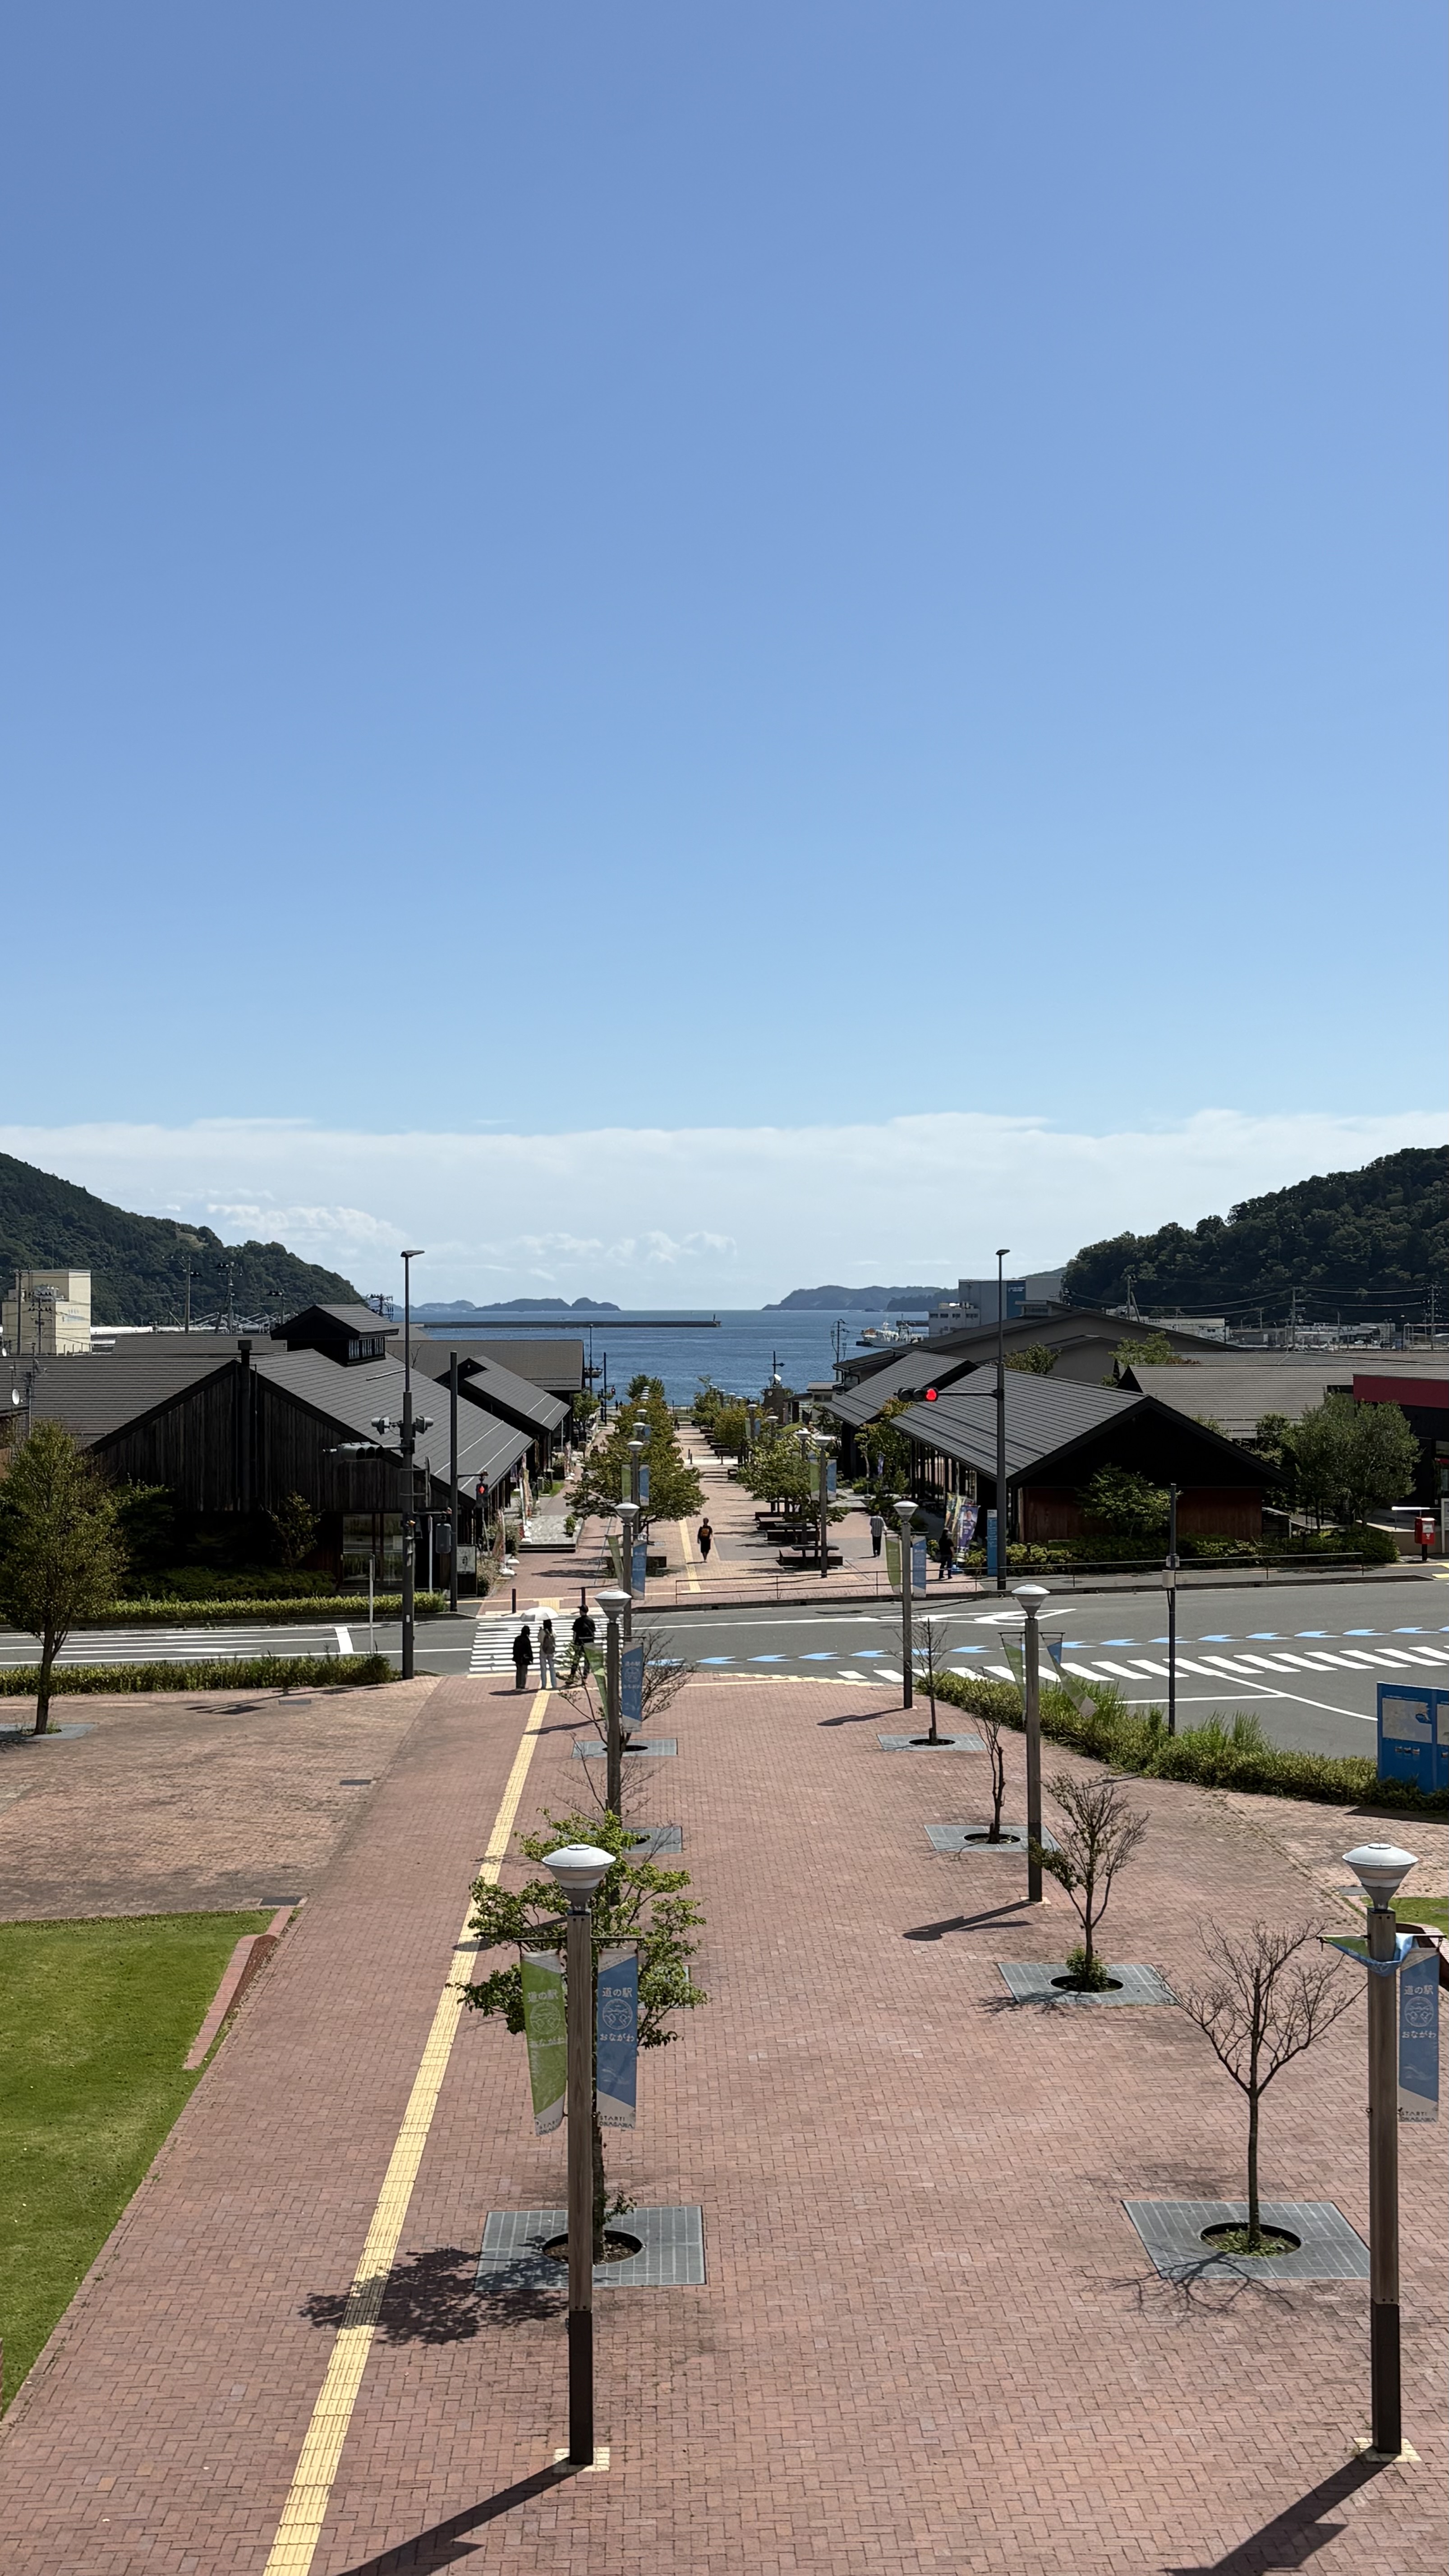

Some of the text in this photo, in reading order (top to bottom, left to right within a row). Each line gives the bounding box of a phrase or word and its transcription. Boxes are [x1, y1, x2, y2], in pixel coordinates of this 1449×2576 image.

[602, 1987, 633, 1998] 道の駅
[1404, 1985, 1433, 1995] 道の駅
[600, 2033, 635, 2042] おながわ
